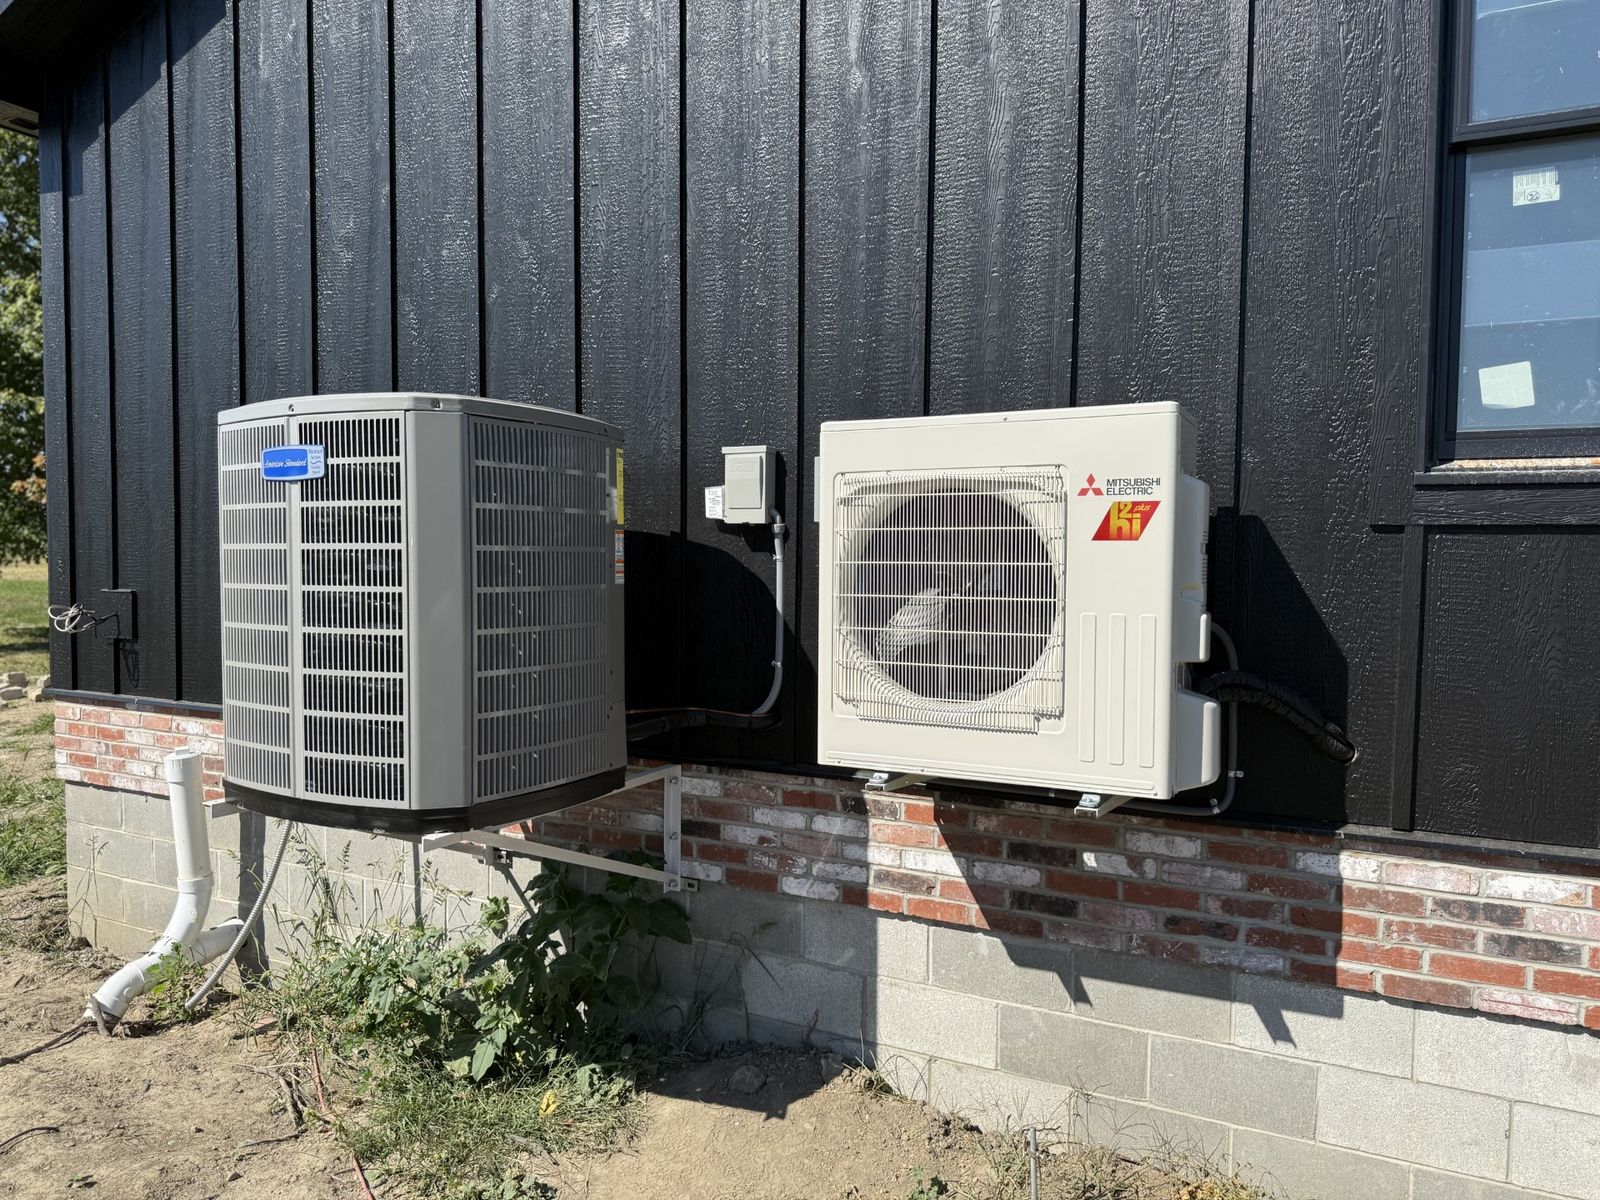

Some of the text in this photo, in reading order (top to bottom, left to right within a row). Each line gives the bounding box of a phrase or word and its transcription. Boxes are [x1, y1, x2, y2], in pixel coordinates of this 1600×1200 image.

[284, 458, 308, 467] Standard
[1106, 478, 1160, 486] MITSUBISHI
[1106, 487, 1153, 495] ELECTRIC
[1133, 504, 1151, 512] plus
